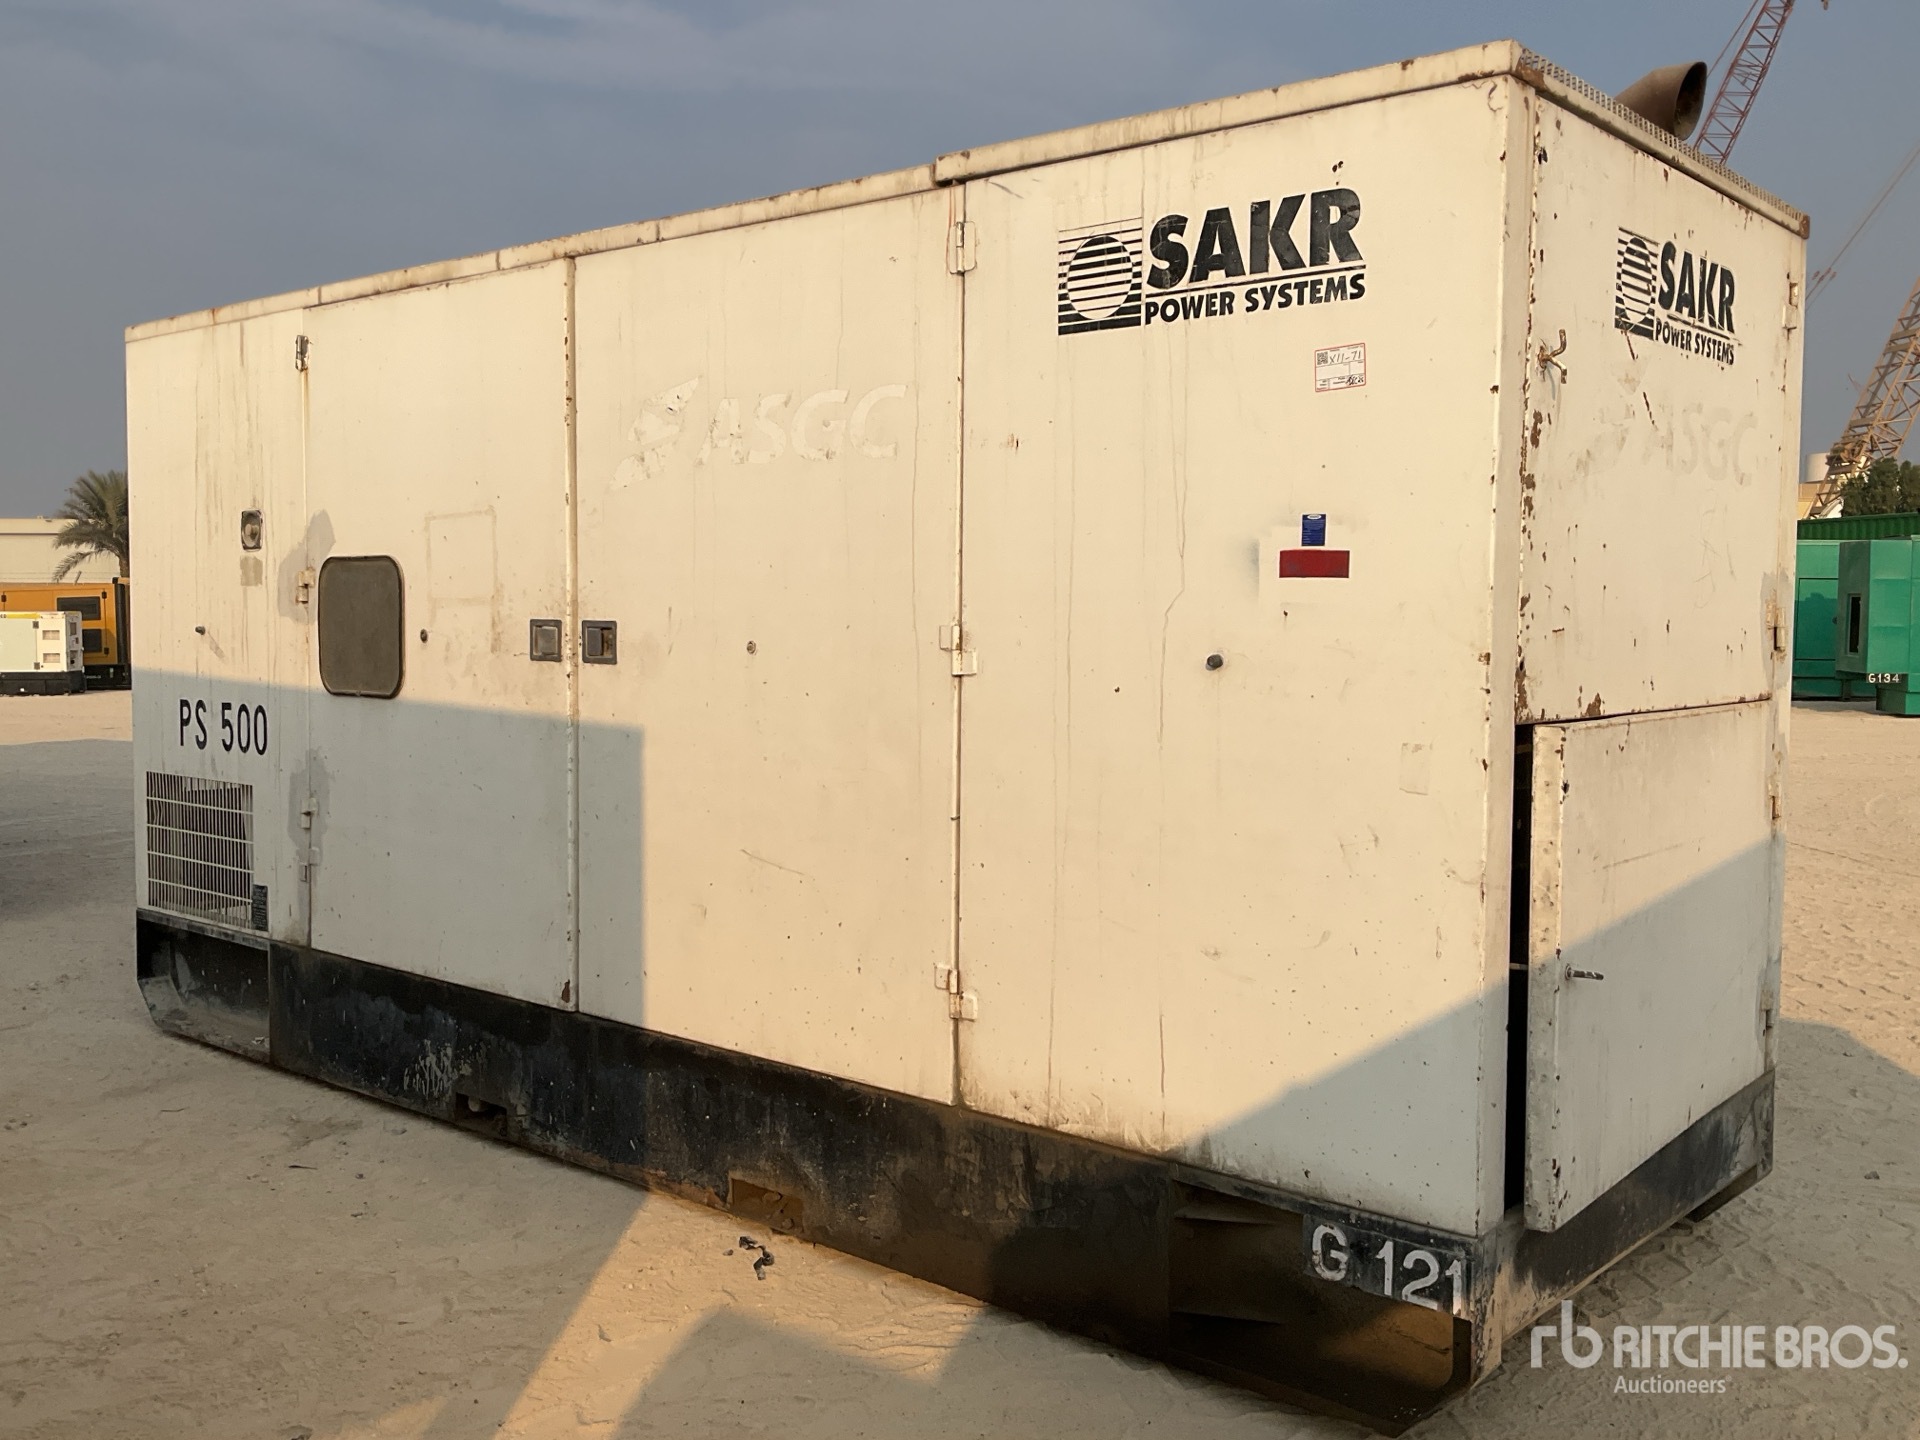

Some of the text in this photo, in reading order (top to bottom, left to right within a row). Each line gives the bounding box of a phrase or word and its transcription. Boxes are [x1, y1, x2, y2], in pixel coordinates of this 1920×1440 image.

[1148, 188, 1363, 289] SAKR
[1145, 273, 1365, 325] POWER SYSTEMS
[1658, 241, 1735, 334] SAKR
[1655, 322, 1734, 365] POWER SYSTEMS
[697, 384, 906, 464] ASGC
[180, 699, 268, 755] PS 500
[1312, 1224, 1462, 1316] G 121
